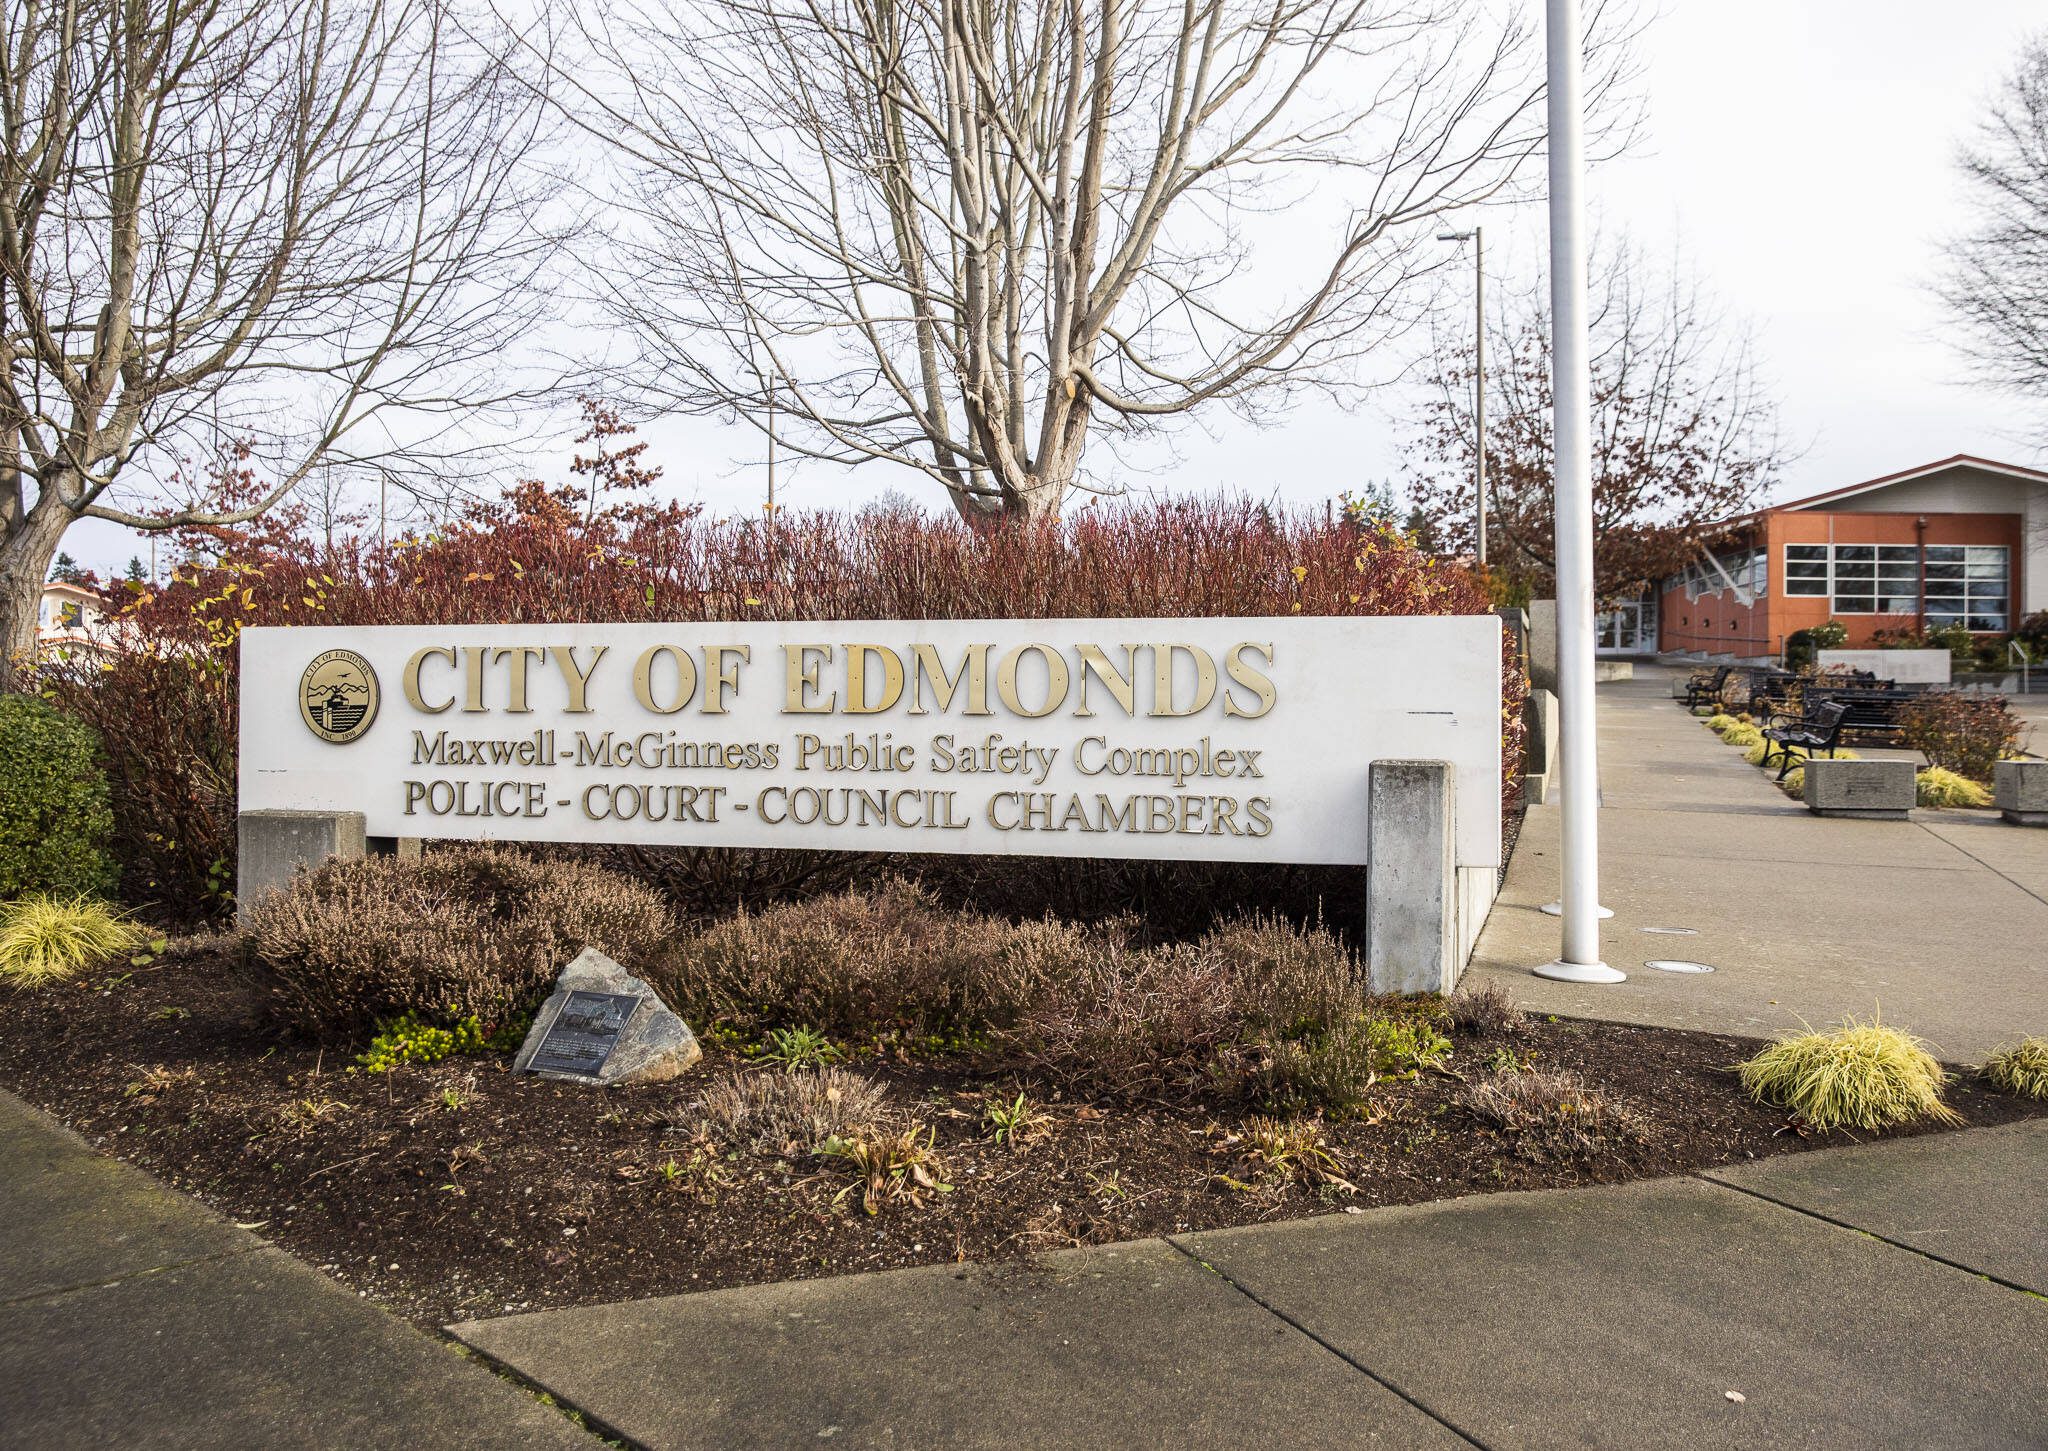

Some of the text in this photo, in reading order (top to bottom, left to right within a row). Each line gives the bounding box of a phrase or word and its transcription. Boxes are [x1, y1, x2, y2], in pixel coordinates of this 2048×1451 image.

[306, 651, 370, 678] CITY OF EDMONDS
[402, 642, 1277, 719] CITY OF EDMONDS
[321, 730, 357, 740] INC 1890
[410, 729, 1265, 787] Maxwell-McGinness Public Safety Complex
[403, 779, 548, 818] POLICE
[582, 783, 728, 823] COURT
[756, 787, 971, 829] COUNCIL
[986, 790, 1274, 837] CHAMBERS
